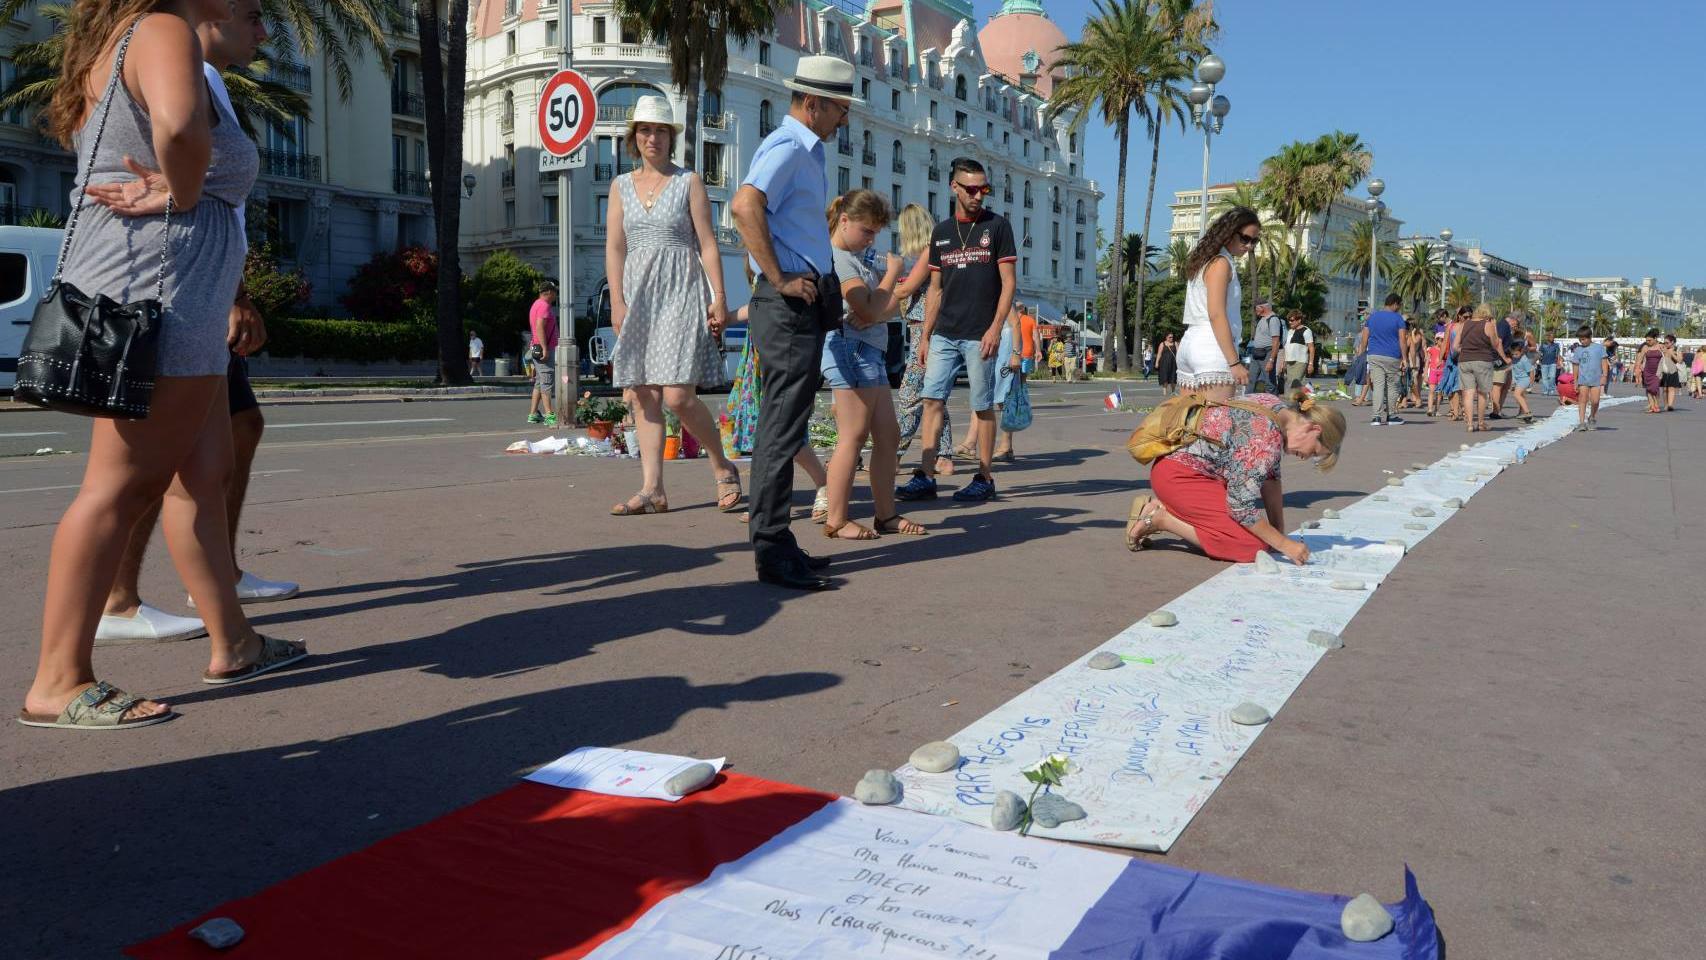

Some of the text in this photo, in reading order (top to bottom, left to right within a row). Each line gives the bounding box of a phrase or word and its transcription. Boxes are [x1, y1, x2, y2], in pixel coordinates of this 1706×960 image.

[549, 94, 579, 131] 50
[542, 151, 581, 166] RAPPEL
[955, 717, 1050, 805] PARTAGEONS
[875, 828, 909, 845] Vous
[854, 847, 879, 863] Ma
[853, 869, 930, 896] DAECH
[764, 899, 801, 921] Nous
